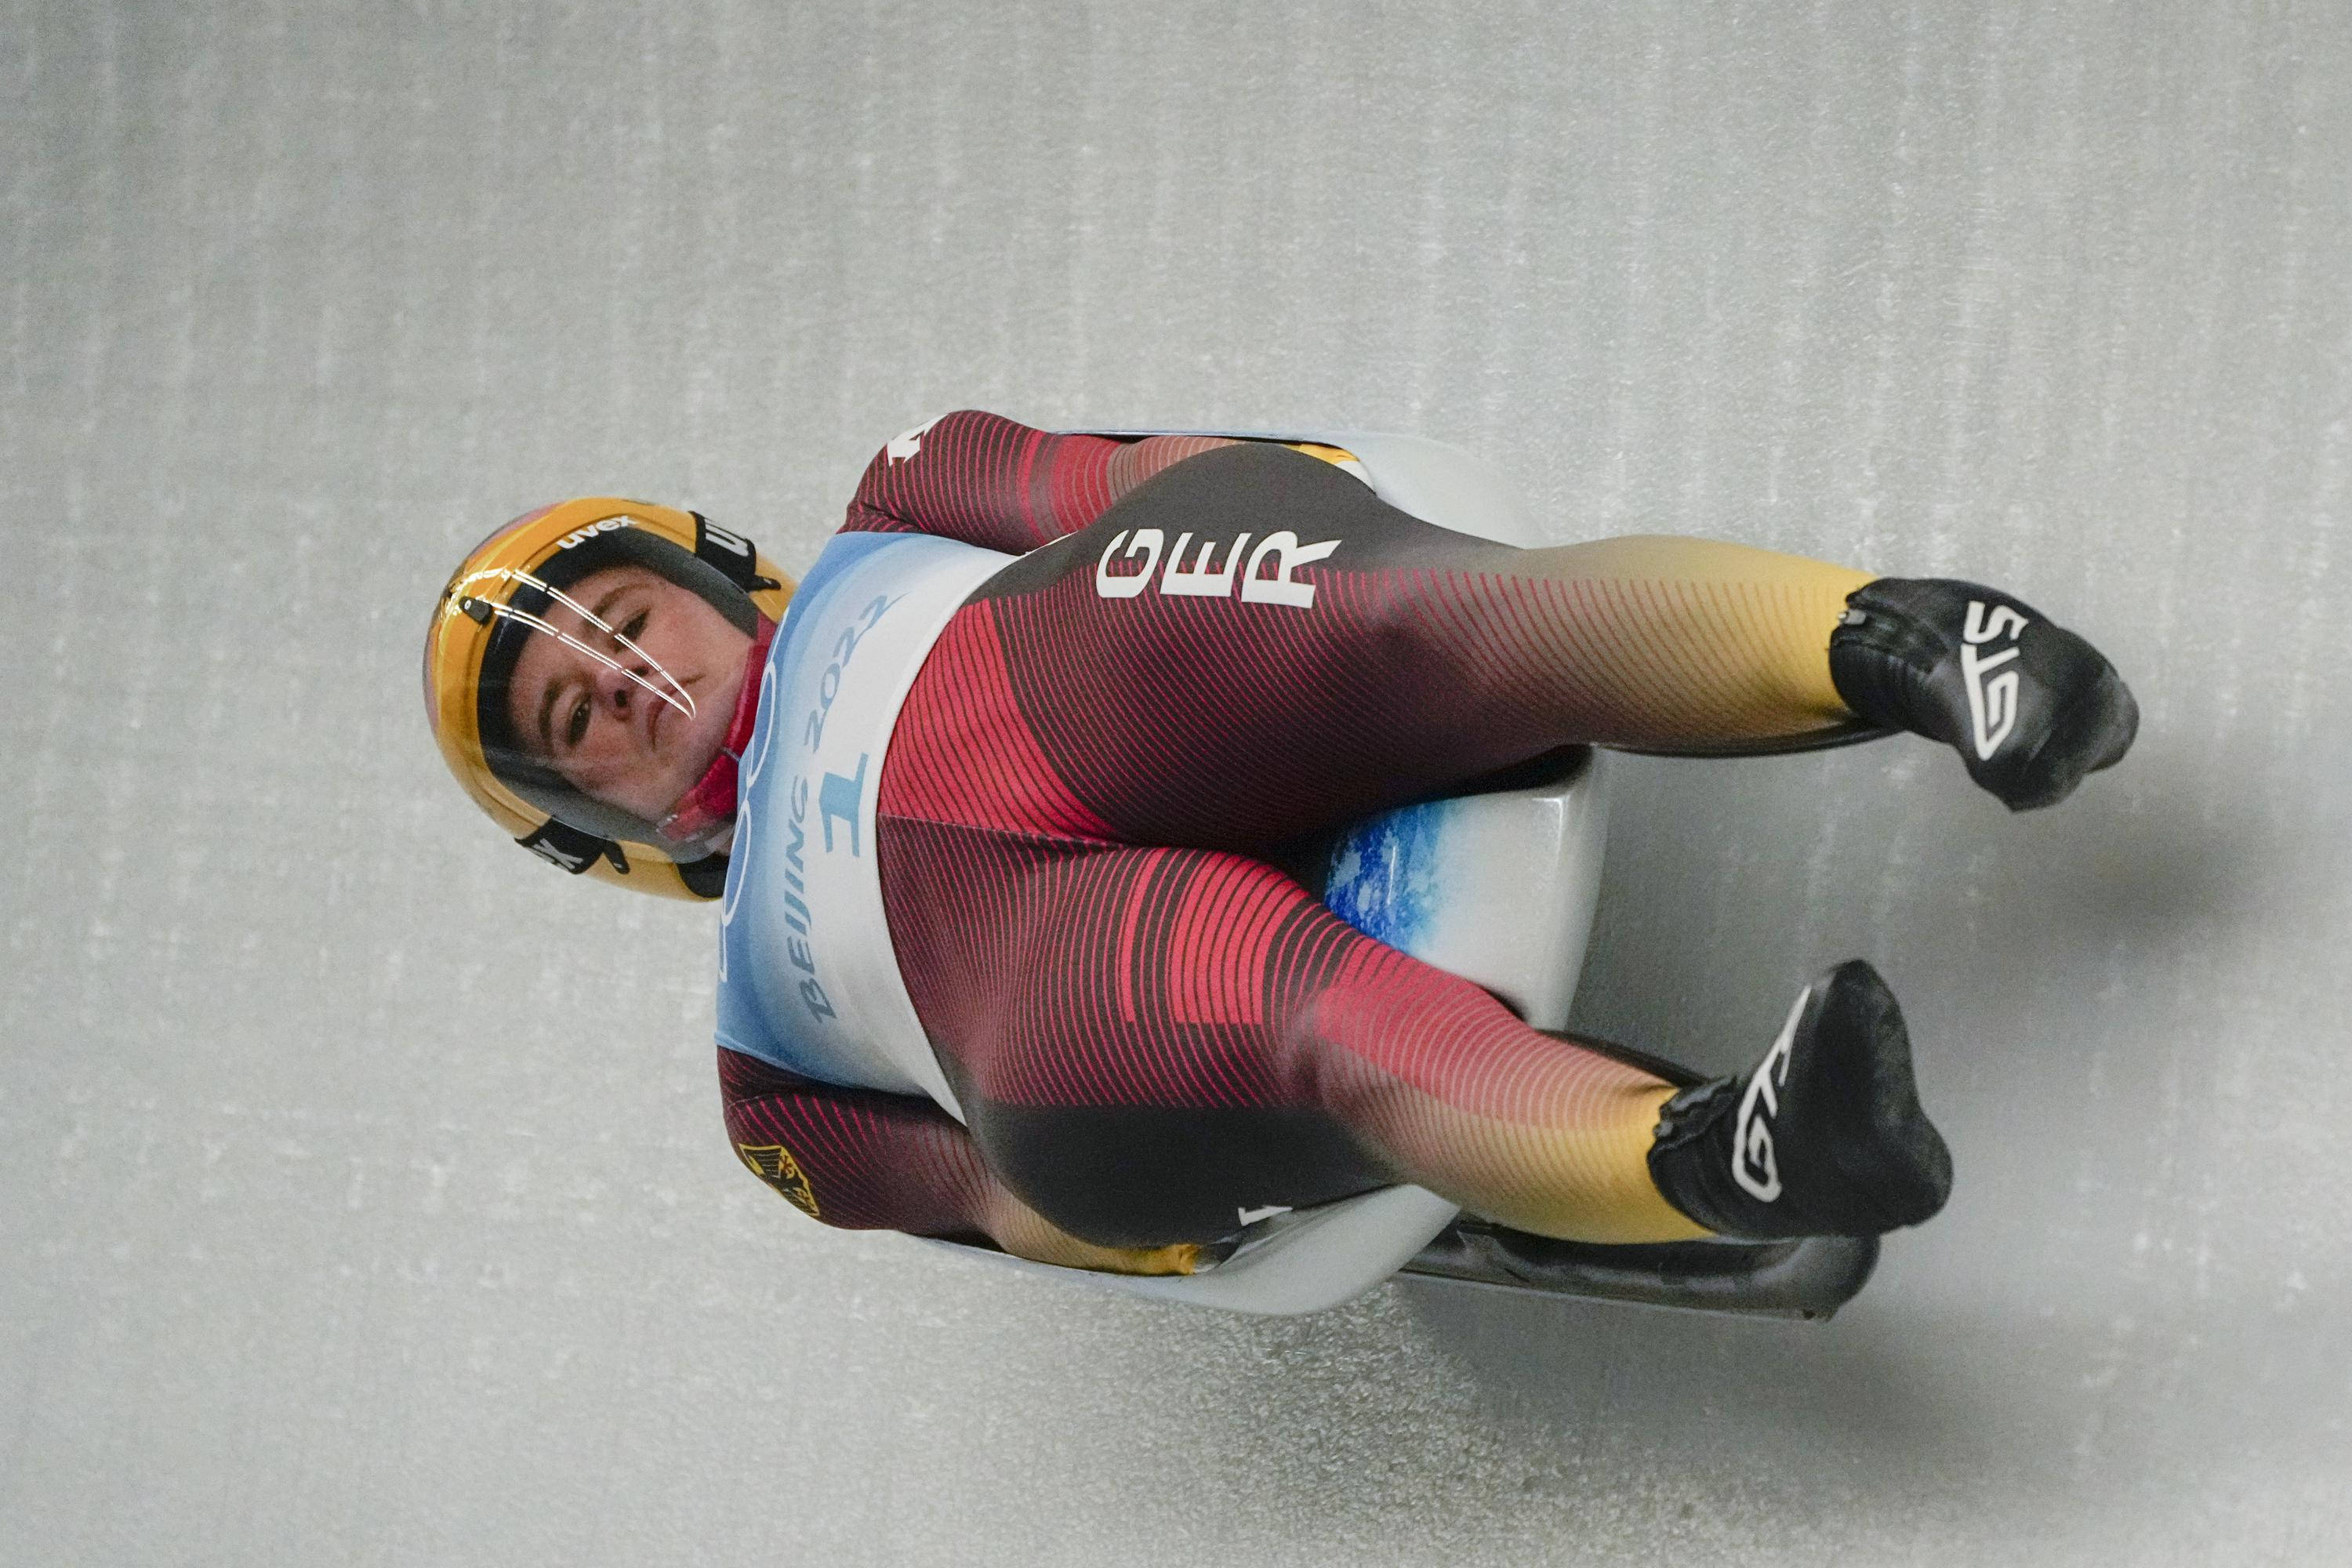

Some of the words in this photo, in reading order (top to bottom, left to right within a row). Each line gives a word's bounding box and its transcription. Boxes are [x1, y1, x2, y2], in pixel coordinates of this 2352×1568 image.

[556, 515, 639, 549] uvex
[1096, 528, 1342, 608] GER
[804, 591, 912, 753] 2022
[1961, 601, 2029, 760] GTS
[818, 753, 869, 858] 1
[785, 775, 837, 1023] BEIJING
